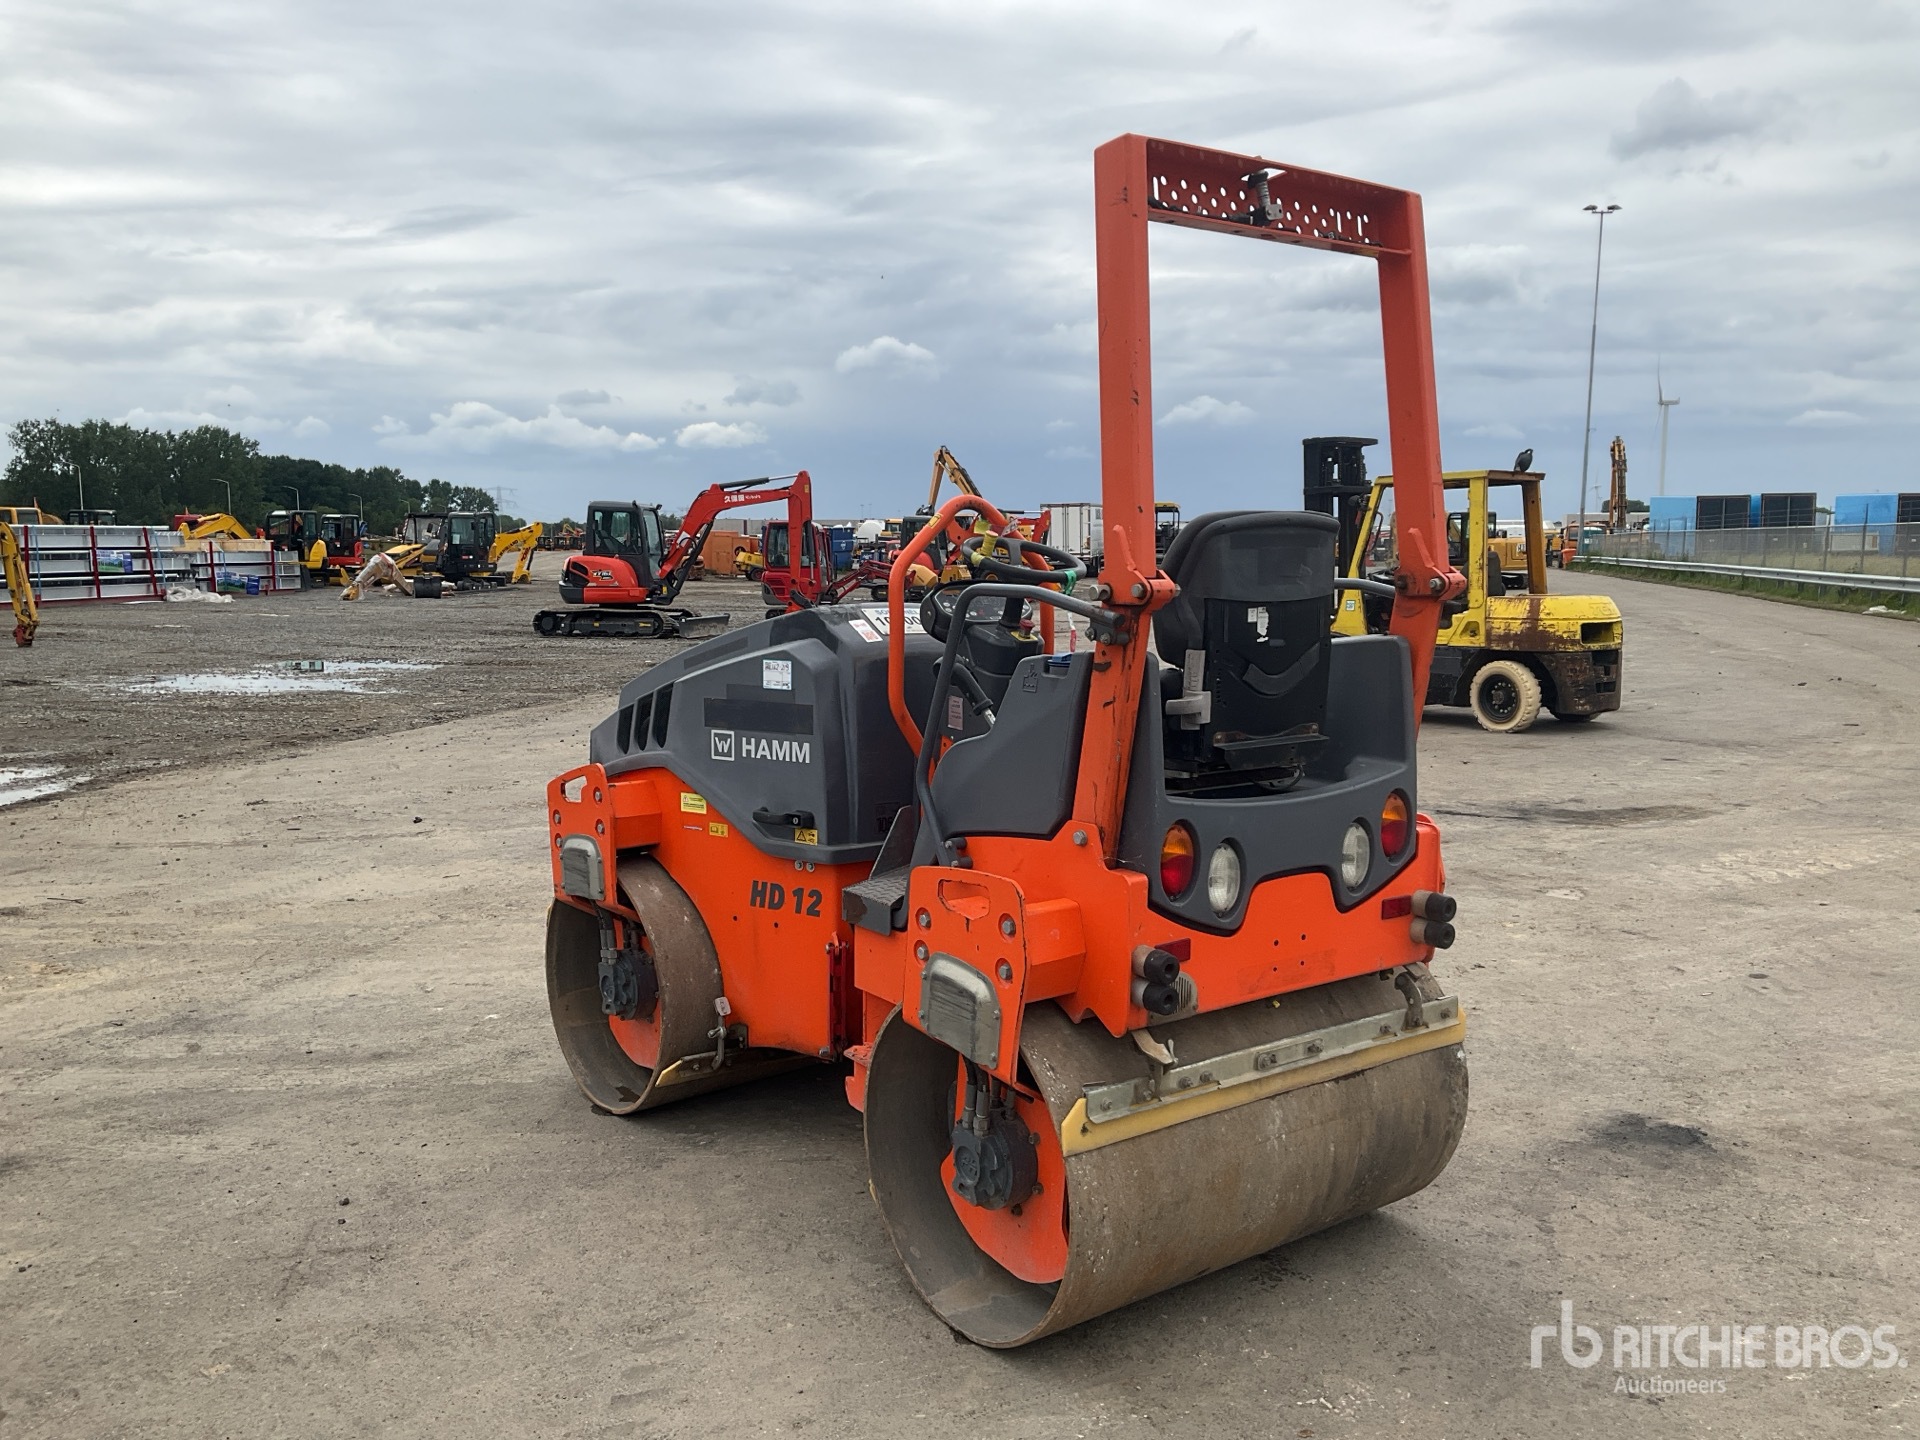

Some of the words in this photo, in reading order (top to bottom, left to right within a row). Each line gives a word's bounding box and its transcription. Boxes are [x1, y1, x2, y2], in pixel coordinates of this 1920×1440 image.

[742, 737, 810, 763] HAMM
[750, 880, 785, 910] HD
[792, 887, 822, 917] 12
